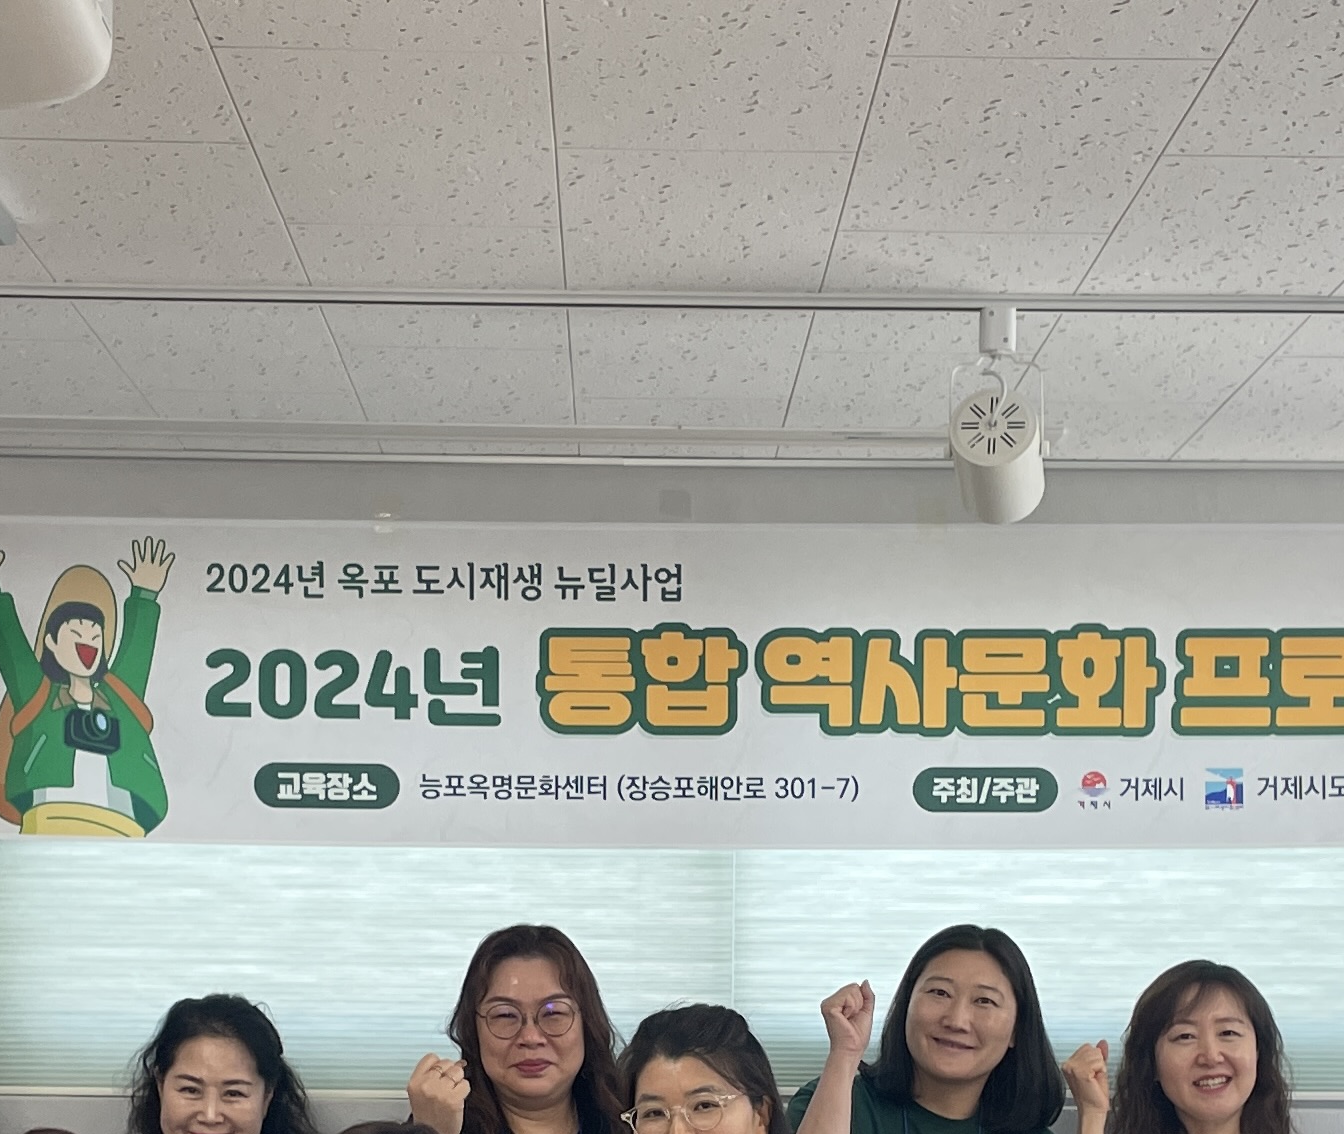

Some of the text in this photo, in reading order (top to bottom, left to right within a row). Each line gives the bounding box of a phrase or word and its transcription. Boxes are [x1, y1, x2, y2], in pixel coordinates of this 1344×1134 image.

[206, 560, 684, 603] 2024년 옥포 도시재생 뉴딜사업
[204, 645, 502, 728] 2024년
[537, 622, 746, 737] 통합
[754, 622, 1167, 738] 역사문화
[276, 772, 378, 802] 교육장소
[419, 773, 860, 803] 능포옥명문화센터 (장승포해안로 301-7)
[932, 776, 1040, 805] 주최/주관
[1119, 776, 1184, 802] 거제시
